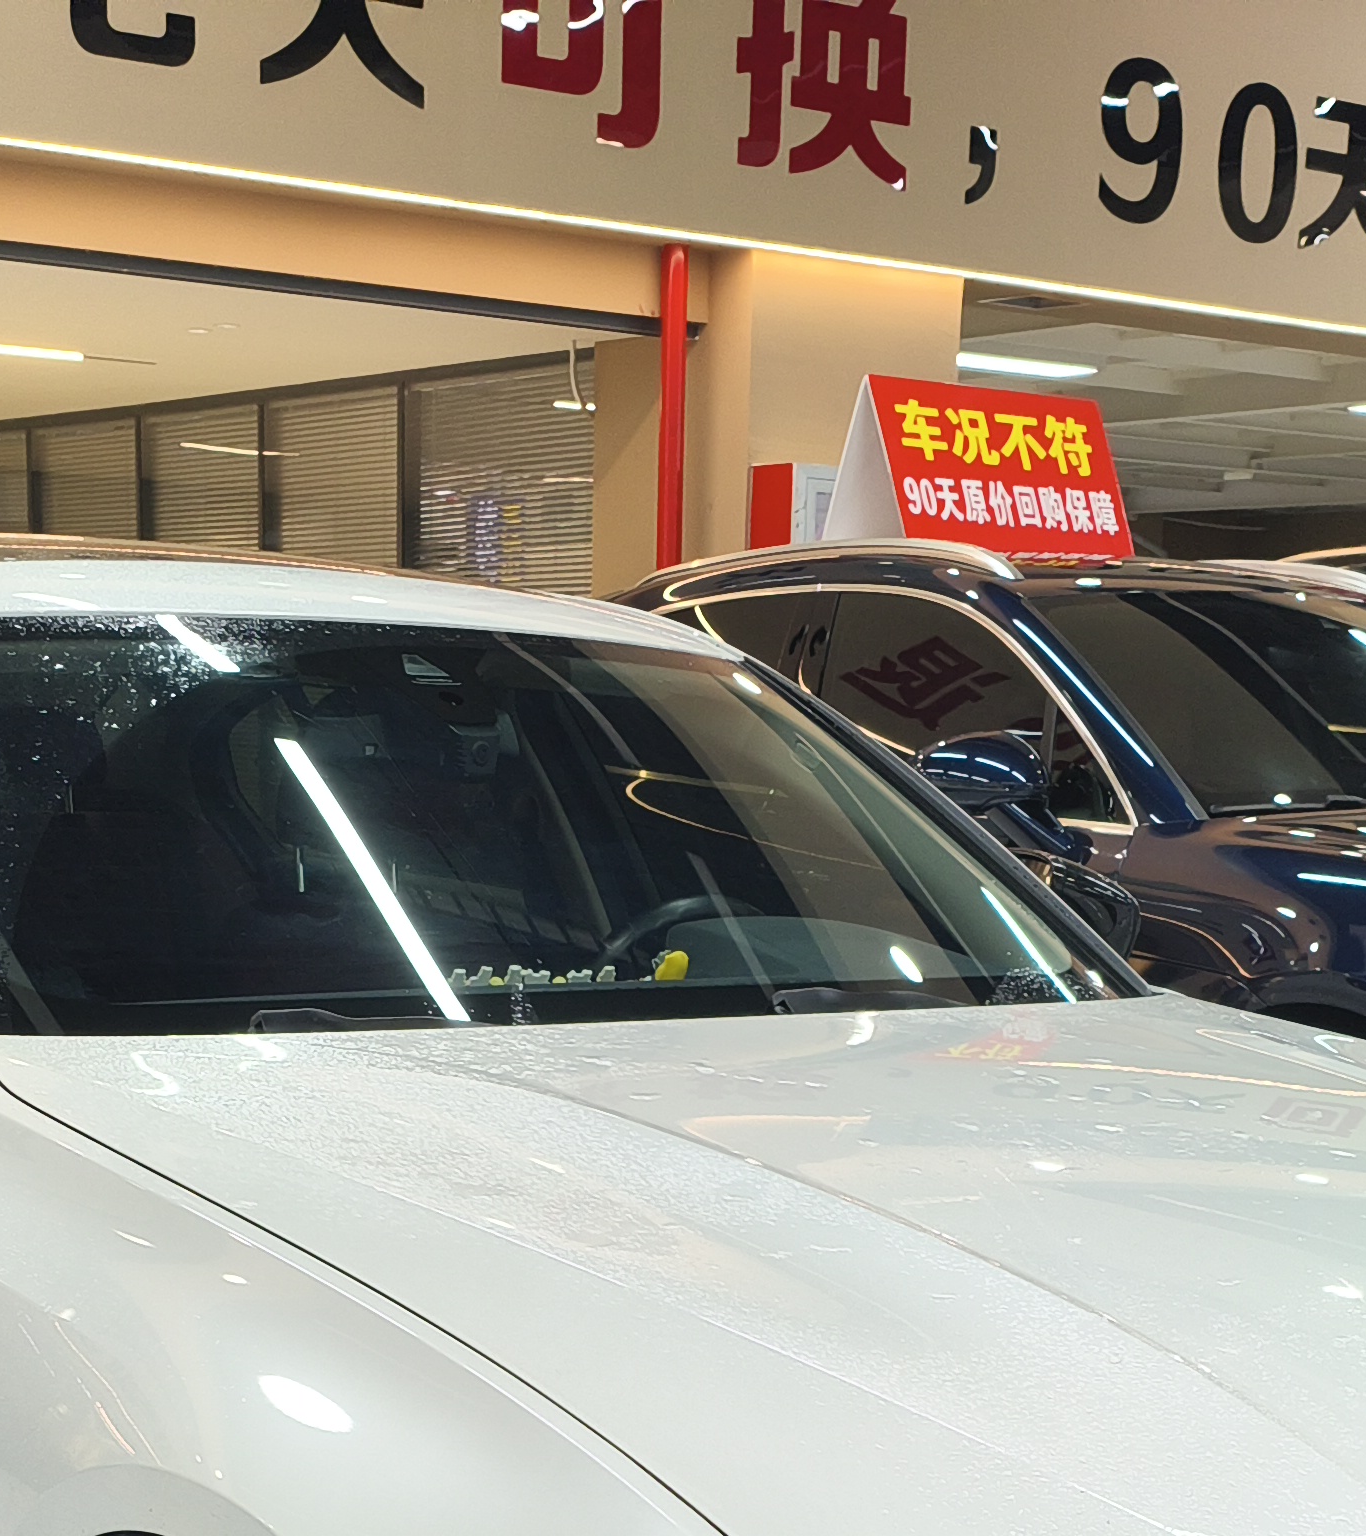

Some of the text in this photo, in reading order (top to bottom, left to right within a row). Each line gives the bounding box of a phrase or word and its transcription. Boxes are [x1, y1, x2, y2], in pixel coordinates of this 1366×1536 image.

[894, 399, 1092, 477] 车况不符
[903, 477, 1119, 536] 90天原价回购保障
